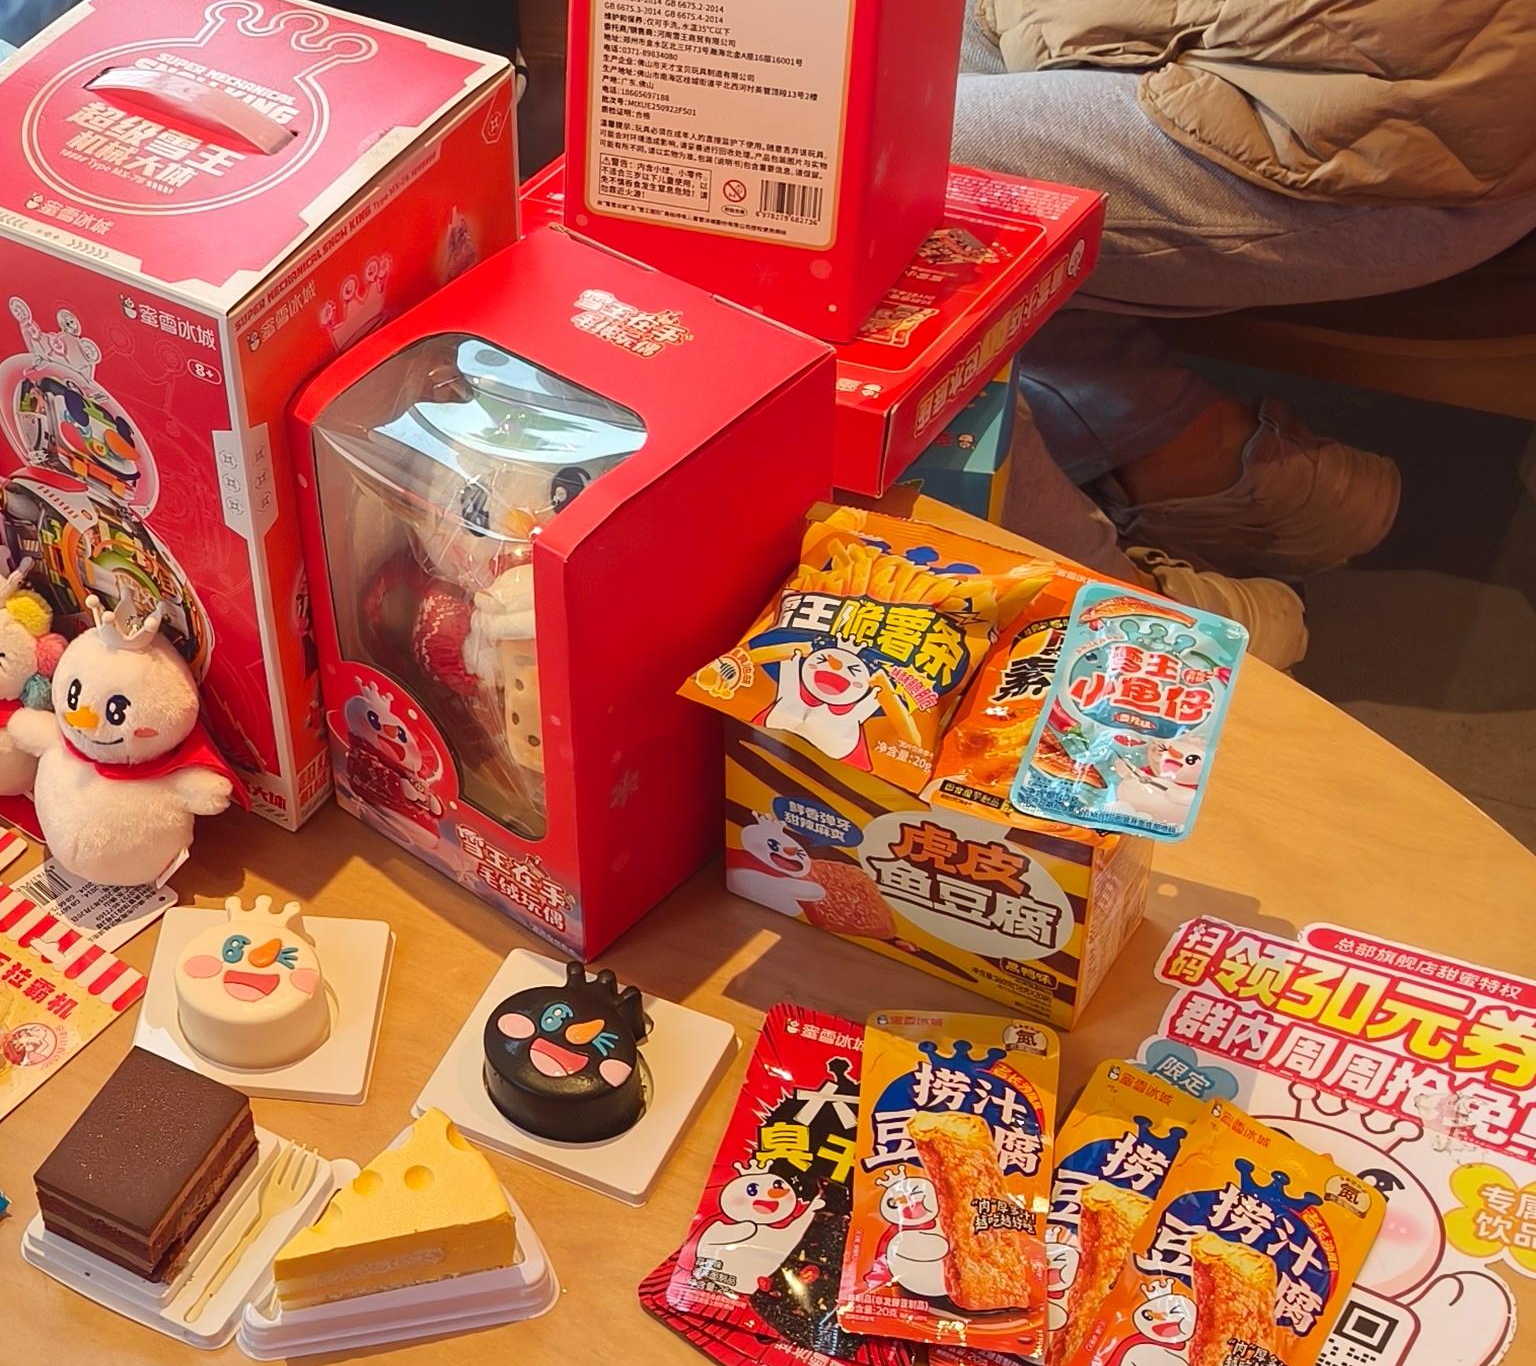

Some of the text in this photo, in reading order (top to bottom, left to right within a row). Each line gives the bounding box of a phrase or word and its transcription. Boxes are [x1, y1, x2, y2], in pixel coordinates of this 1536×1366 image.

[604, 2, 615, 10] GB
[665, 10, 675, 18] GB
[665, 0, 676, 7] GB
[157, 53, 207, 76] SUPER
[205, 69, 297, 106] MECHANICAL
[65, 101, 246, 176] 超级雪王
[40, 199, 114, 236] 蜜雪冰城
[139, 303, 216, 350] 蜜雪冰城
[261, 282, 316, 341] 蜜雪冰城
[571, 289, 688, 347] 雪王在手
[194, 363, 215, 379] 8+
[1109, 645, 1180, 683] 雪王
[1070, 673, 1213, 723] 小鱼仔
[875, 740, 934, 773] 净含量:20g
[788, 800, 852, 830] 鲜香弹牙
[458, 823, 568, 908] 雪王在手
[894, 822, 1028, 894] 虎皮
[477, 864, 565, 932] 毛绒玩偶
[868, 857, 1064, 949] 鱼豆腐
[1166, 919, 1228, 984] 扫码
[1332, 935, 1525, 1001] 总部旗舰店甜蜜特权
[1212, 935, 1536, 1088] 领30元券
[913, 1062, 1027, 1125] 捞汁
[1120, 1072, 1174, 1107] 蜜雪冰城
[1156, 1055, 1210, 1096] 限定
[864, 1108, 1042, 1174] 豆腐
[1220, 1111, 1271, 1148] 蜜雪冰城
[1208, 1183, 1326, 1277] 捞汁
